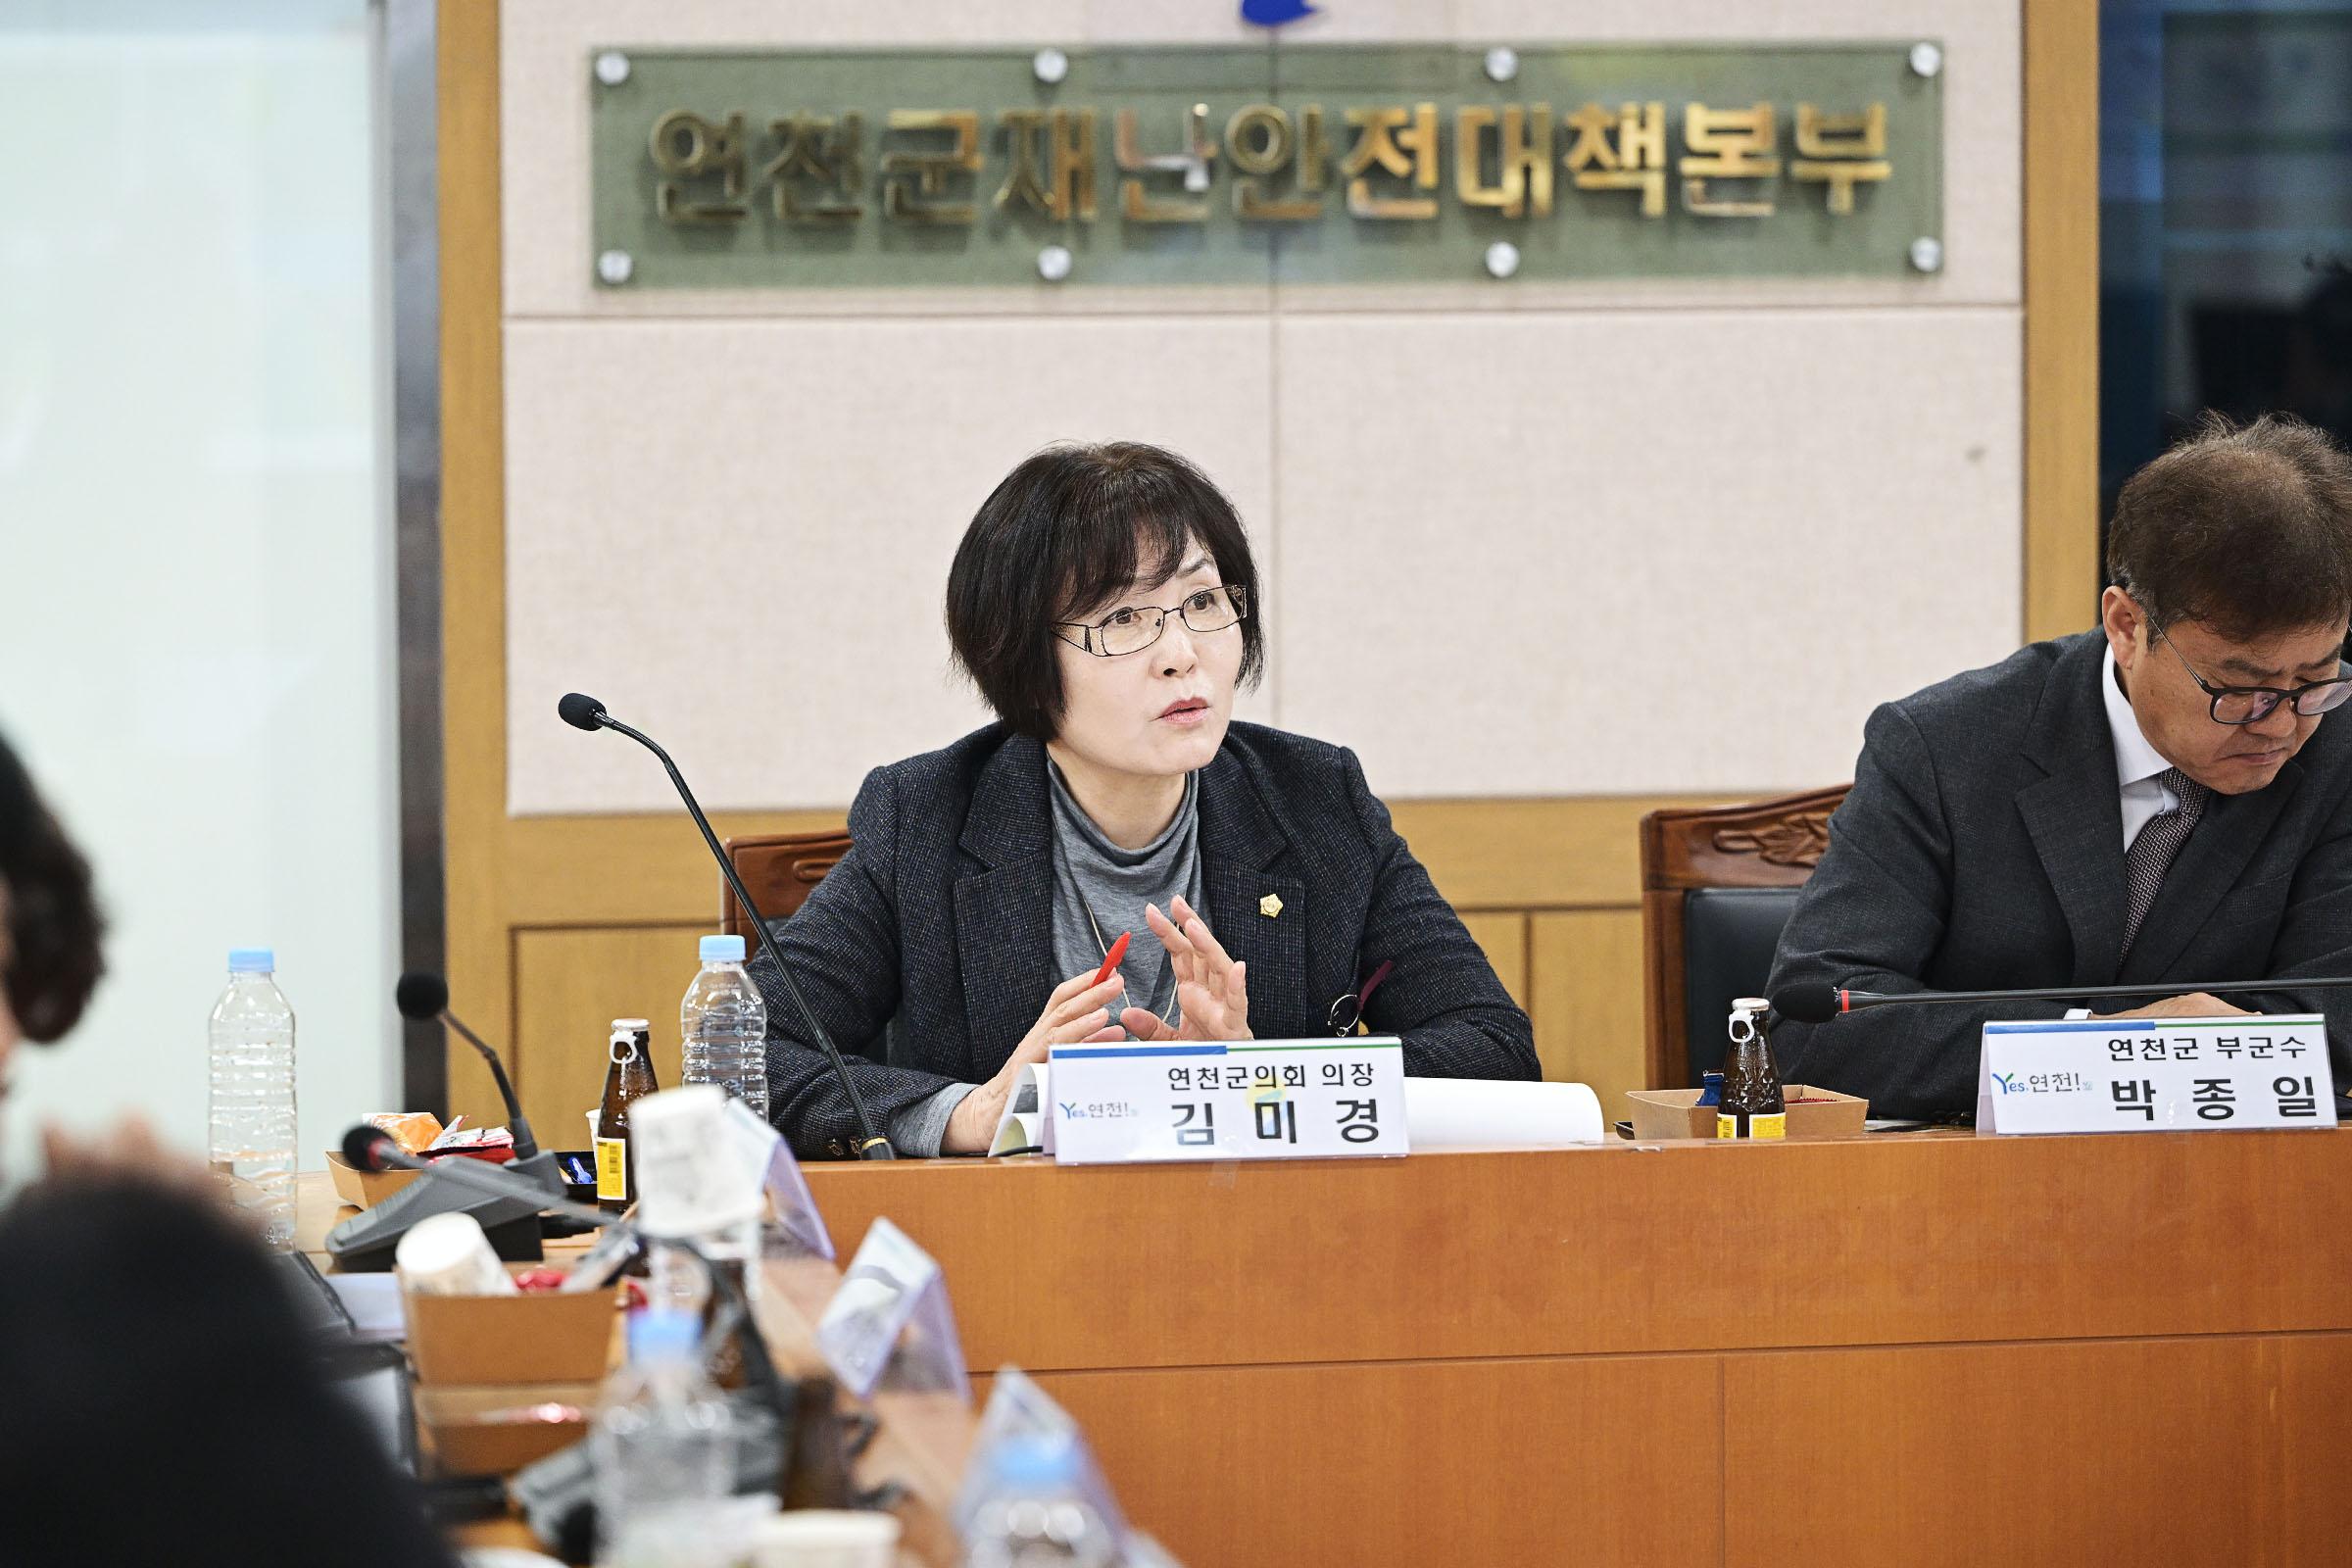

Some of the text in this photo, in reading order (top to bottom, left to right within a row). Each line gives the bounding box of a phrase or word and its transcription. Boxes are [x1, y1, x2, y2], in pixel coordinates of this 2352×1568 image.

[2107, 1035, 2308, 1061] 연천군 부군수
[1167, 1062, 1375, 1092] 연천군의회 의장
